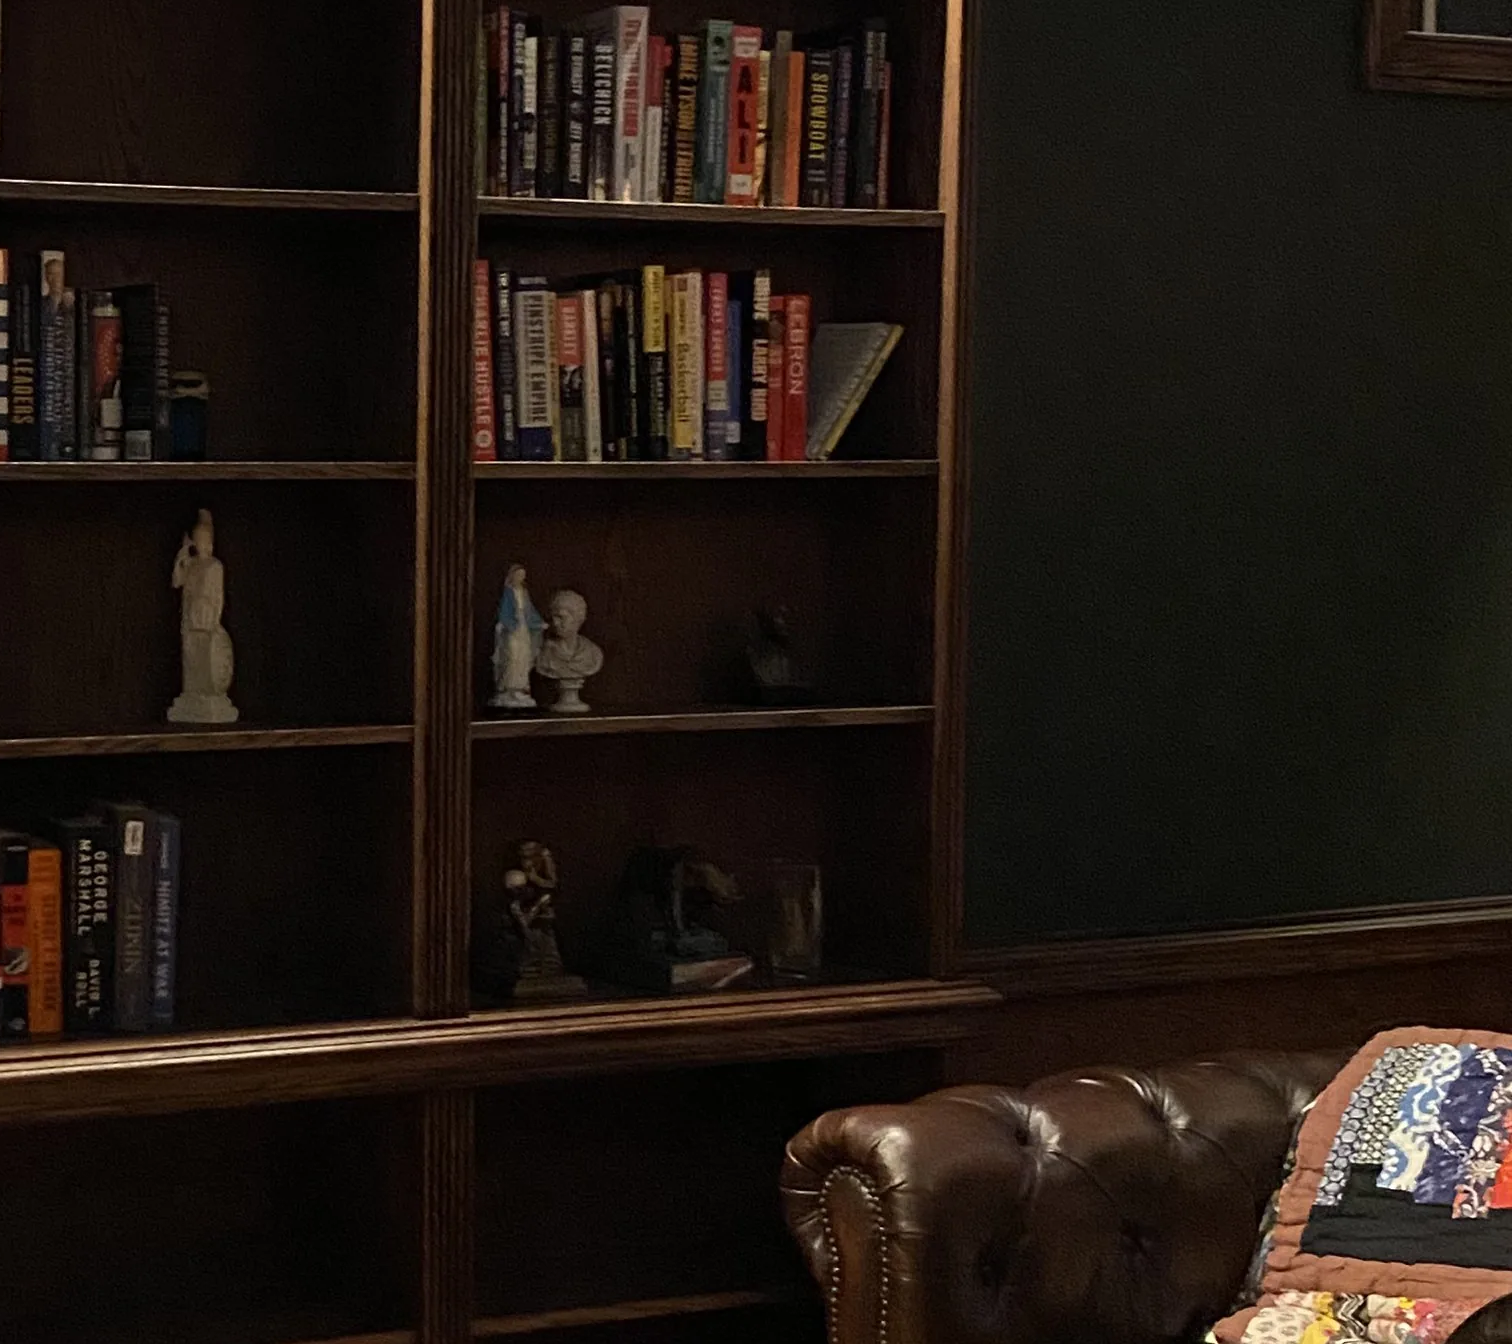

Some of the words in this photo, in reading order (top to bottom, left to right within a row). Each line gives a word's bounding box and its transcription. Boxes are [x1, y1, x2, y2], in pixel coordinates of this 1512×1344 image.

[593, 44, 614, 125] BELICHICK
[808, 72, 829, 161] SHOWBOAT
[474, 284, 489, 356] CHARLIE
[529, 295, 548, 366] PINSTRIPE
[788, 297, 806, 395] LEBRON
[11, 357, 35, 425] LEADERS
[477, 360, 492, 424] HUSTLE
[531, 373, 550, 423] EMPIRE
[76, 838, 92, 937] MARSHALL
[92, 850, 108, 924] GEORGE
[89, 959, 101, 1001] DAVID
[155, 963, 171, 999] WAR
[156, 939, 170, 957] AT
